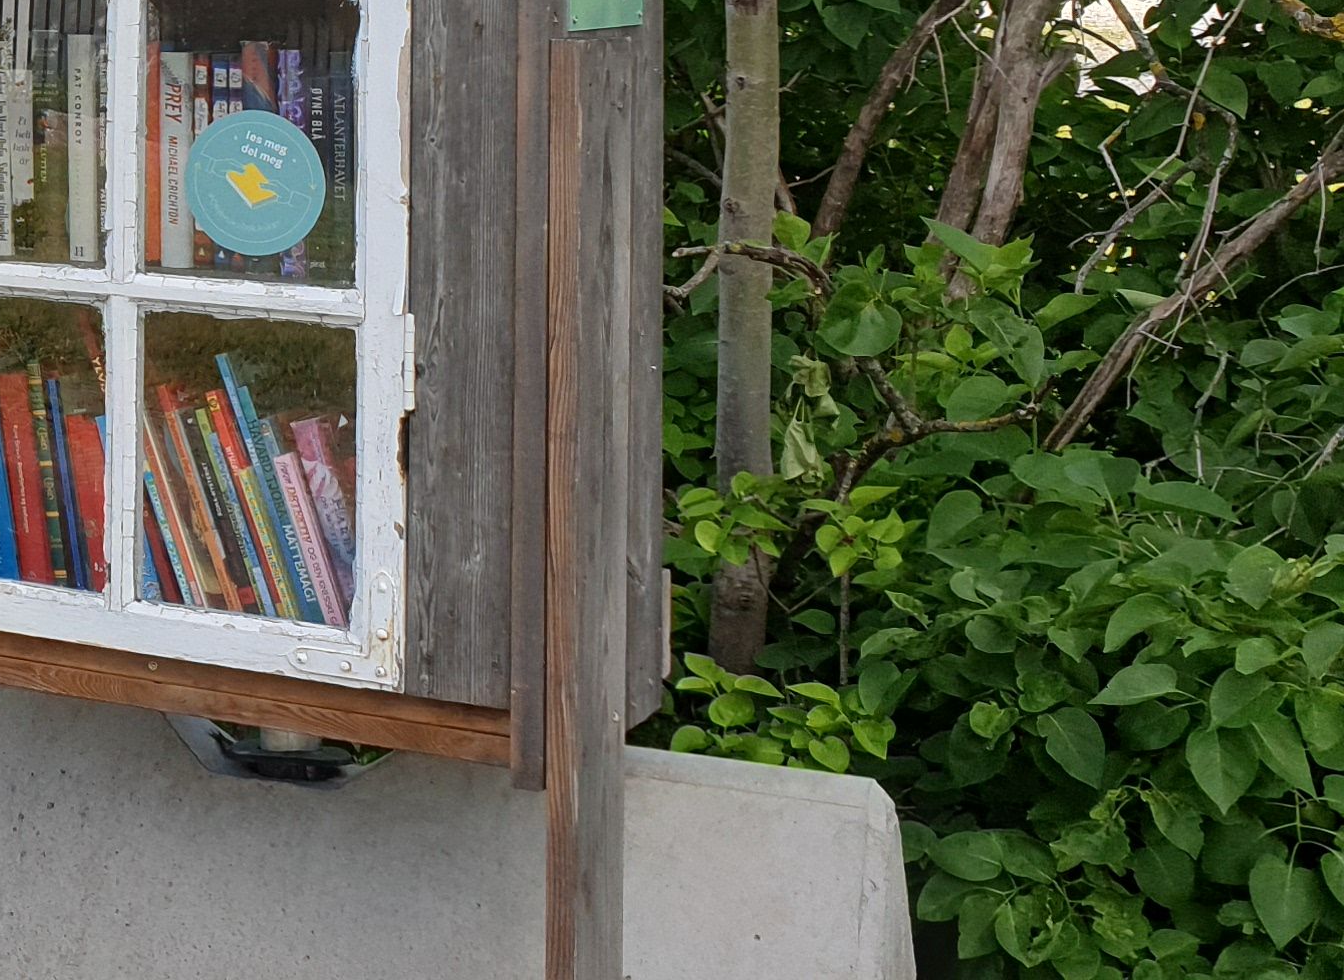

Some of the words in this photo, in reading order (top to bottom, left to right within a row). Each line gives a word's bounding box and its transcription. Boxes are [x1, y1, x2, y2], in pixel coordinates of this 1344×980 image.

[73, 67, 81, 89] PAT
[164, 82, 182, 124] PREY
[309, 86, 323, 116] ØYNE
[73, 94, 81, 145] CONROY
[310, 119, 326, 141] BLÅ
[167, 135, 178, 176] MICHAEL
[240, 143, 258, 158] del
[259, 152, 284, 170] meg
[245, 130, 262, 144] les
[264, 139, 288, 156] meg
[332, 91, 347, 202] ATLANTERHAVET
[167, 178, 178, 225] CRICHTON
[266, 476, 289, 524] TJORA
[281, 524, 317, 603] MATTEMAGI
[307, 546, 318, 563] OG
